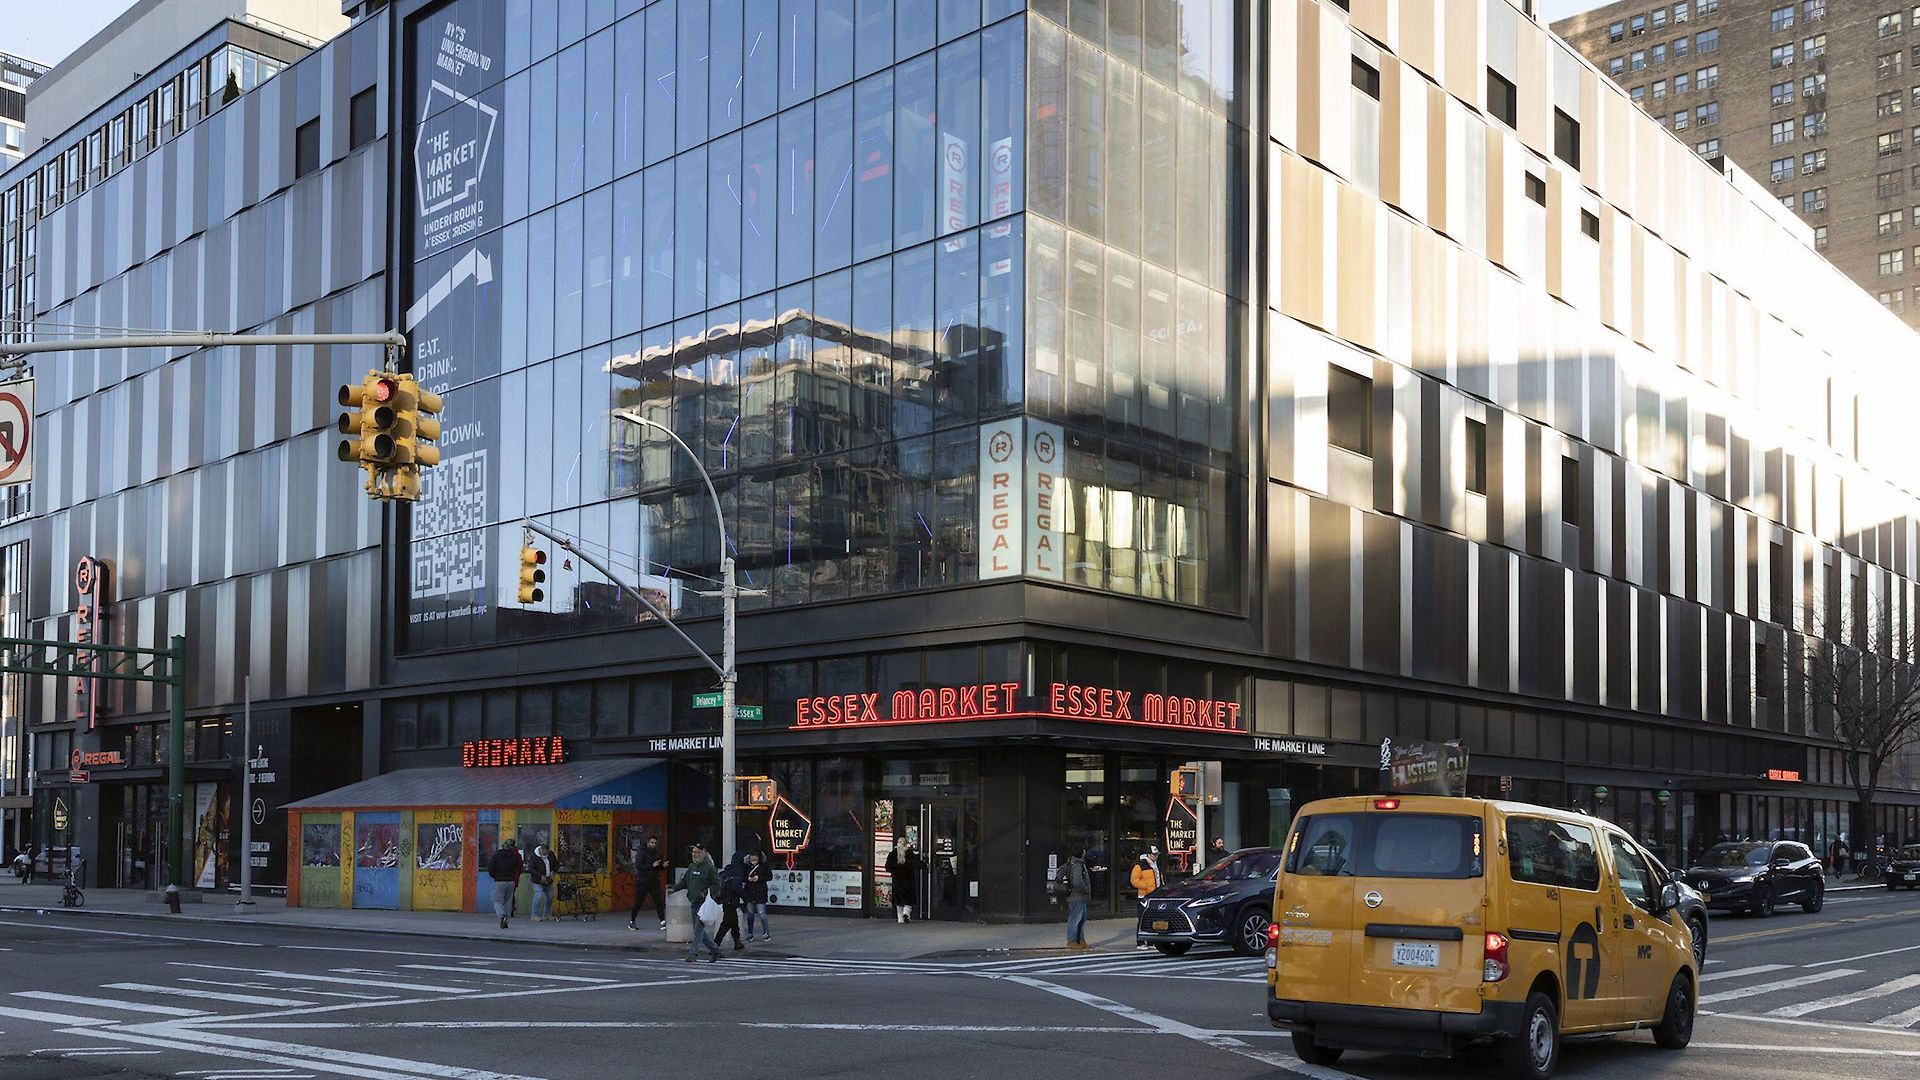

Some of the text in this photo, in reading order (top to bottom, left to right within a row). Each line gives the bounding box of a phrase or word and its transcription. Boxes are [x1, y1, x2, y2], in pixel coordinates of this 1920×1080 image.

[441, 37, 491, 71] UNDERGROUND
[436, 53, 465, 77] MARKET
[426, 139, 476, 180] MARKET
[431, 227, 450, 247] ESSEX
[418, 338, 441, 360] EAT.
[418, 356, 457, 382] DRINK.
[441, 421, 485, 447] DOWN.
[992, 473, 1010, 571] REGAL
[1037, 472, 1053, 572] REGAL
[696, 696, 717, 707] Delancey
[796, 683, 1019, 726] ESSEX MARKET
[1050, 682, 1241, 729] ESSEX MARKET
[736, 707, 755, 718] Essex
[649, 736, 724, 751] THE MARKET LIN
[1254, 738, 1326, 755] THE MARKET LINE
[84, 751, 121, 766] REGAL
[775, 819, 789, 828] THE
[1170, 819, 1183, 829] THE
[775, 829, 804, 839] MARKET
[1170, 830, 1195, 839] MARKET
[775, 839, 791, 848] LINE
[1170, 840, 1185, 849] LINE
